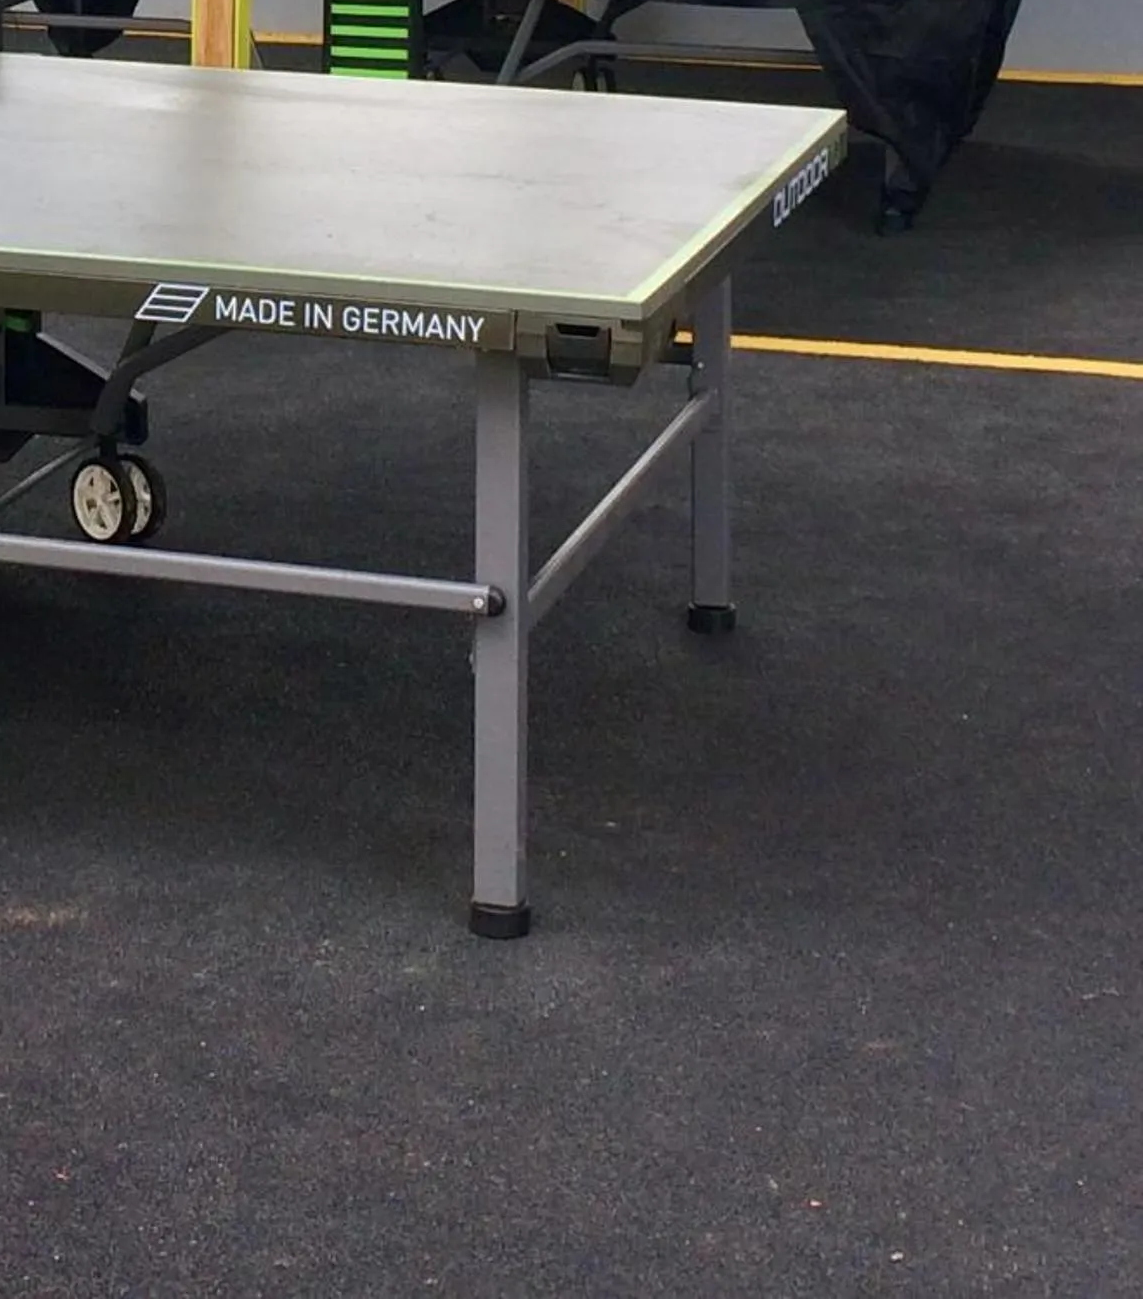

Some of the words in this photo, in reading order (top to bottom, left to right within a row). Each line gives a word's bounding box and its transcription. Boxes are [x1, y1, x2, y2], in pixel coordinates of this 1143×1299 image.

[773, 147, 828, 227] OUTDOOR
[215, 294, 296, 326] MADE
[304, 302, 333, 329] IN
[342, 306, 485, 342] GERMANY
